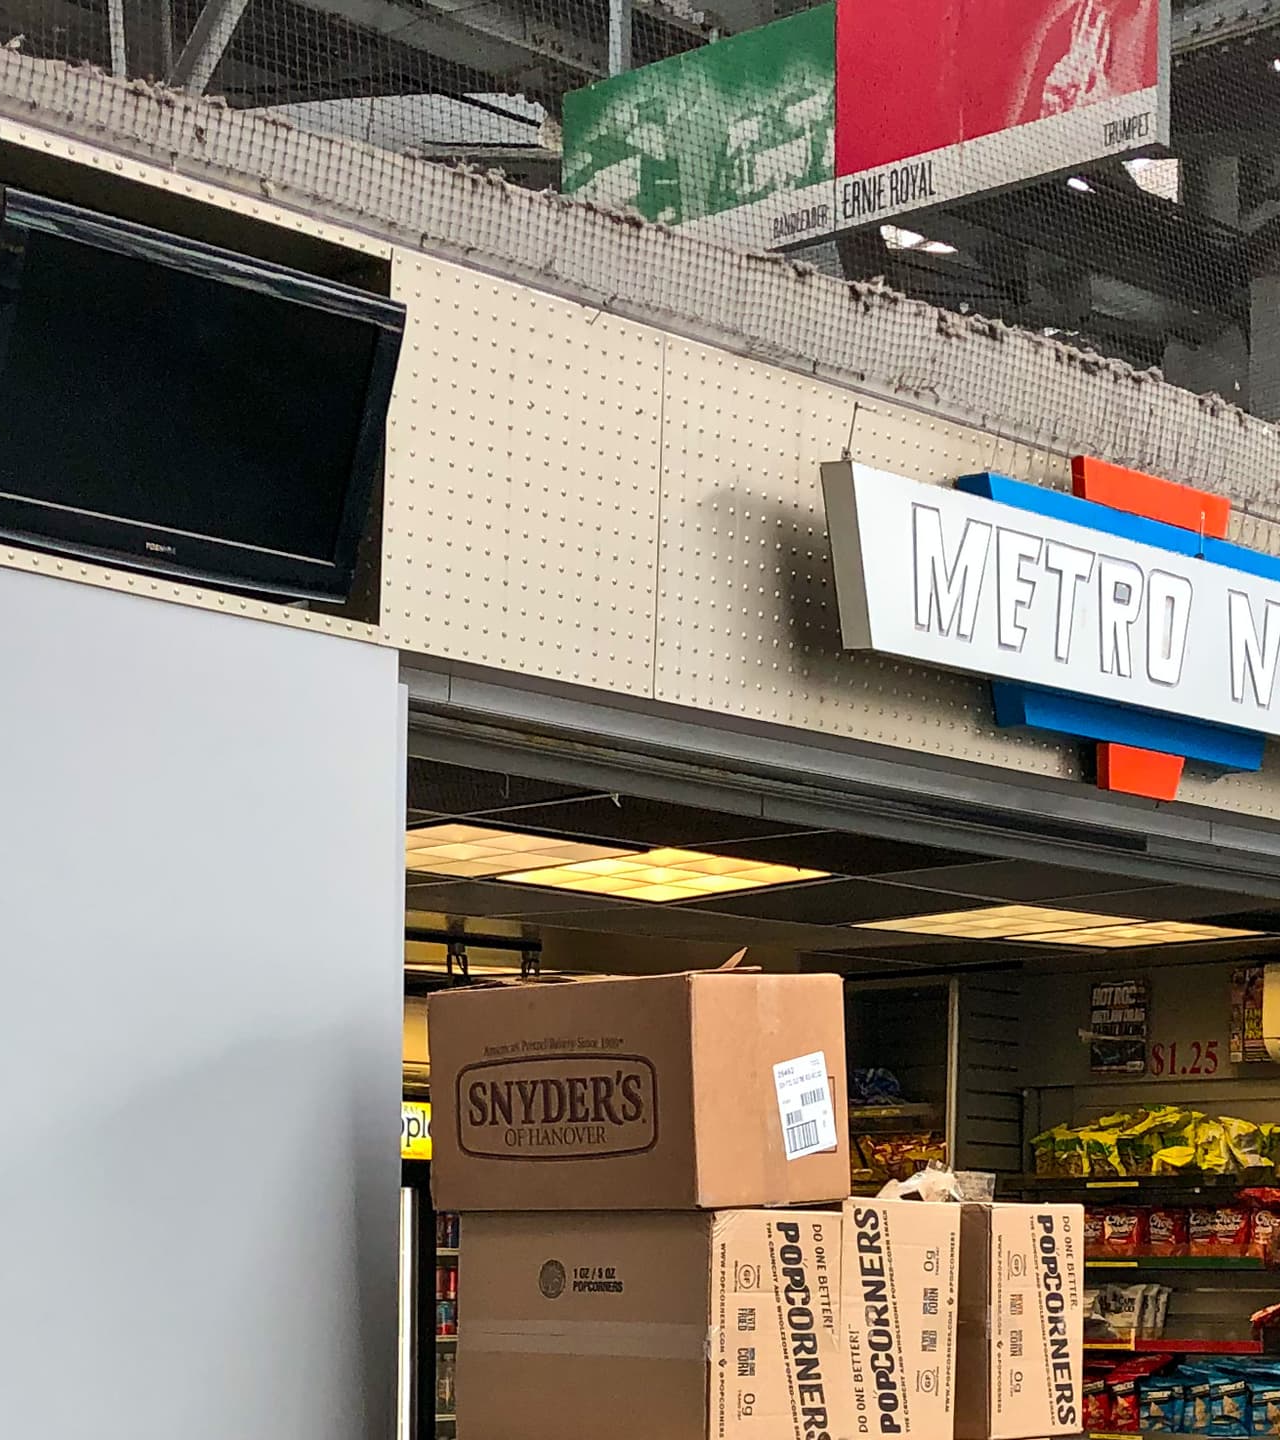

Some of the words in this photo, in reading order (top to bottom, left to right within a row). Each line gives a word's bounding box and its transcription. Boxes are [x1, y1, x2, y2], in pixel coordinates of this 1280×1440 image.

[841, 172, 886, 220] ERNIE
[889, 159, 937, 208] ROYAL
[910, 501, 1193, 688] METRO
[1151, 1040, 1218, 1076] $1.25
[468, 1070, 642, 1127] SNYDER'S
[504, 1129, 526, 1147] OF
[528, 1126, 608, 1146] HANOVER
[812, 1224, 822, 1241] DO
[1062, 1216, 1070, 1232] DO
[815, 1247, 826, 1270] ONE
[1064, 1237, 1073, 1258] ONE
[768, 1241, 778, 1282] CRUNCHY
[923, 1250, 935, 1272] 0g
[573, 1267, 578, 1279] 1
[579, 1267, 590, 1279] OZ
[605, 1267, 616, 1279] OZ
[743, 1270, 751, 1283] GF
[573, 1281, 624, 1293] POPCORNERS
[928, 1288, 938, 1314] CORN
[737, 1308, 747, 1331] FRIED
[747, 1308, 755, 1331] NEVER
[854, 1208, 901, 1433] POPCORNERS
[1037, 1215, 1076, 1425] POPCORNERS
[737, 1349, 749, 1376] CORN
[850, 1330, 863, 1382] BETTER!
[742, 1393, 755, 1416] 0g
[856, 1387, 866, 1411] ONE
[858, 1416, 868, 1432] DO
